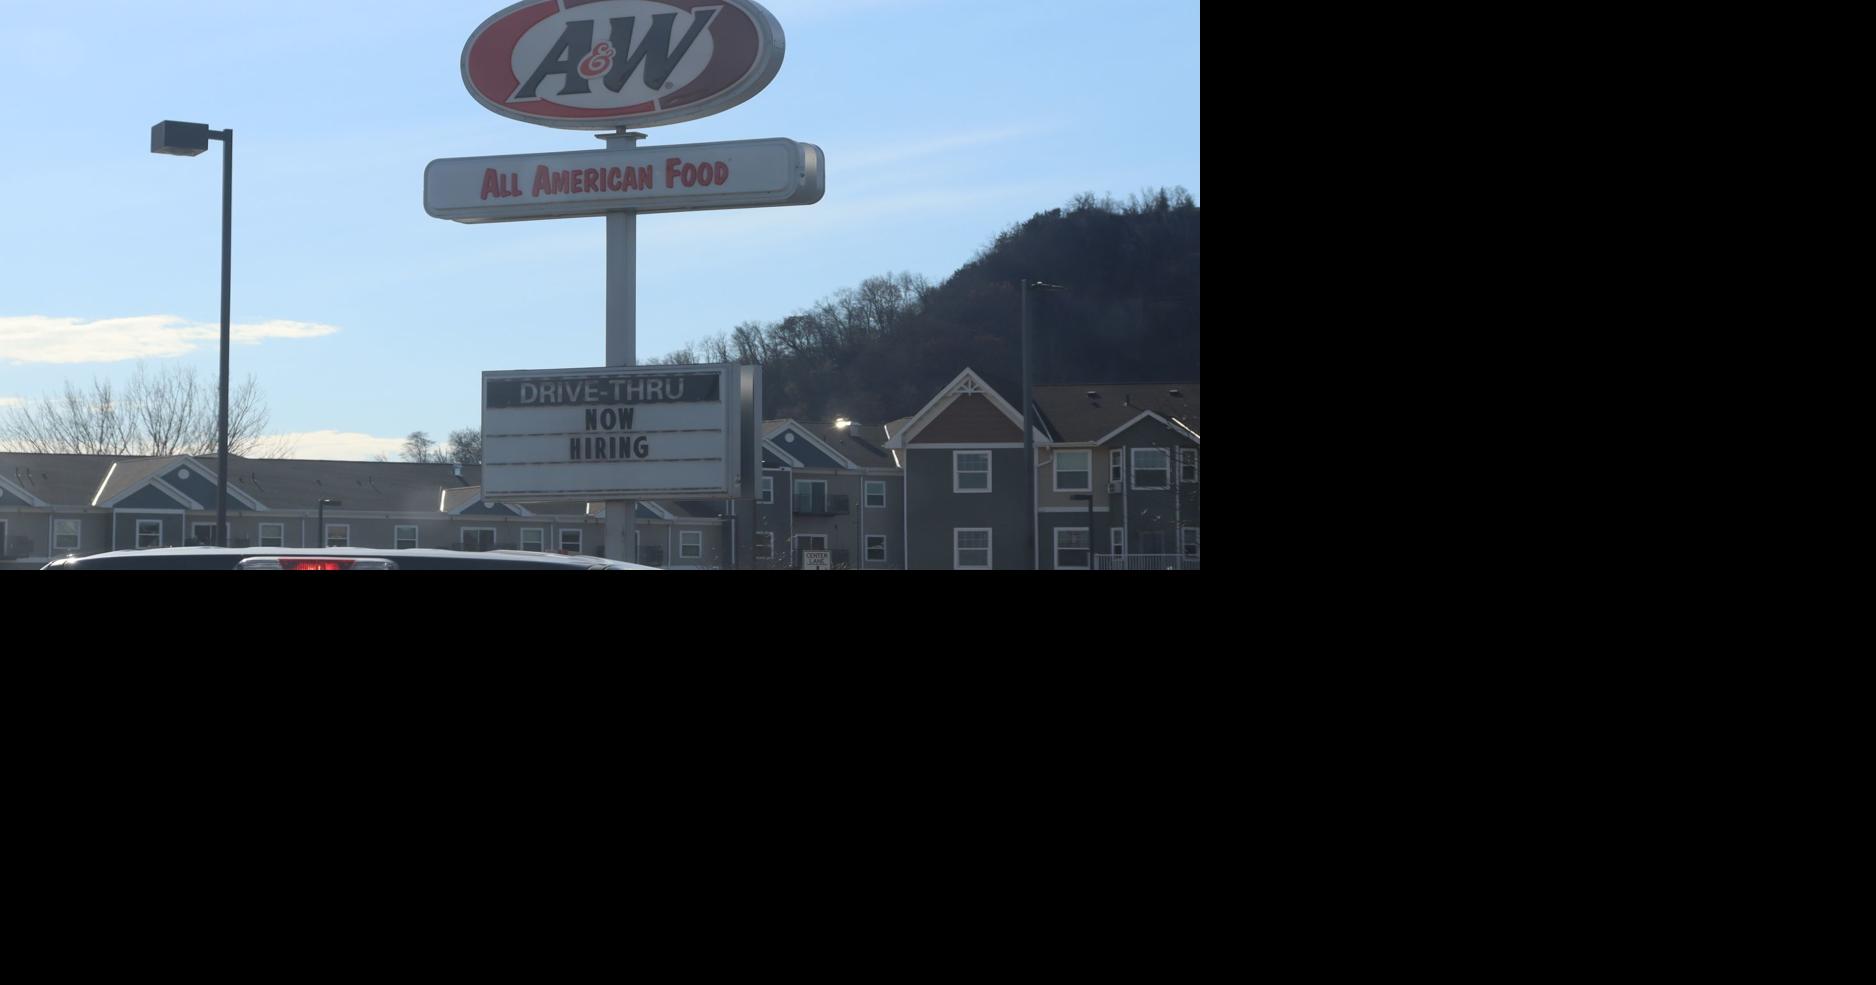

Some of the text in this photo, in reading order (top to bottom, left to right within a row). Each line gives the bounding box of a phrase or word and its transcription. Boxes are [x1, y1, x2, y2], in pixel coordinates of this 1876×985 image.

[510, 7, 720, 99] A&W
[480, 157, 730, 200] ALL AMERICAN FOOD
[520, 378, 685, 404] DRIVE-THRU
[585, 408, 634, 431] NOW
[570, 436, 649, 460] HIRING
